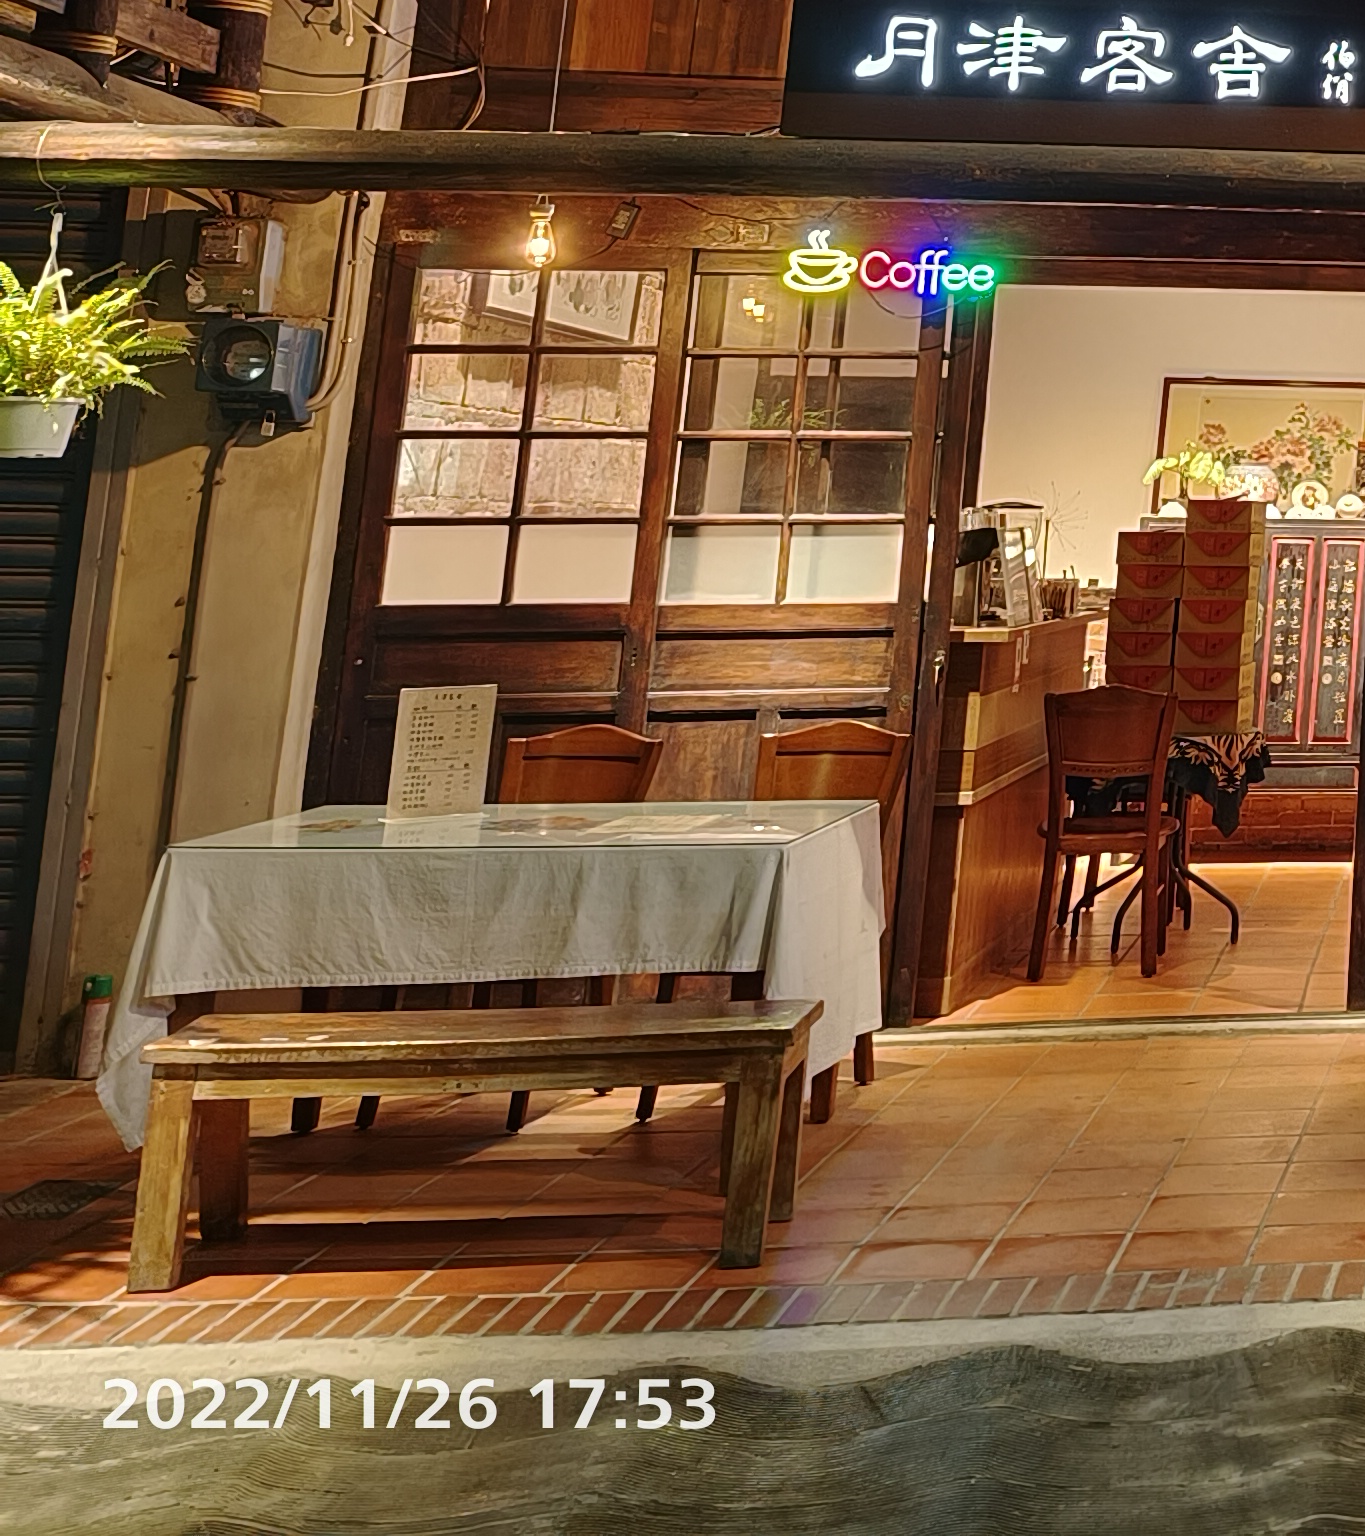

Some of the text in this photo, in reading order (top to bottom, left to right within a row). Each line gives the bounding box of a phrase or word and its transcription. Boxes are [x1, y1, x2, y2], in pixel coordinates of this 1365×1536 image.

[855, 15, 1291, 99] 月津客舍
[860, 249, 994, 295] Coffee
